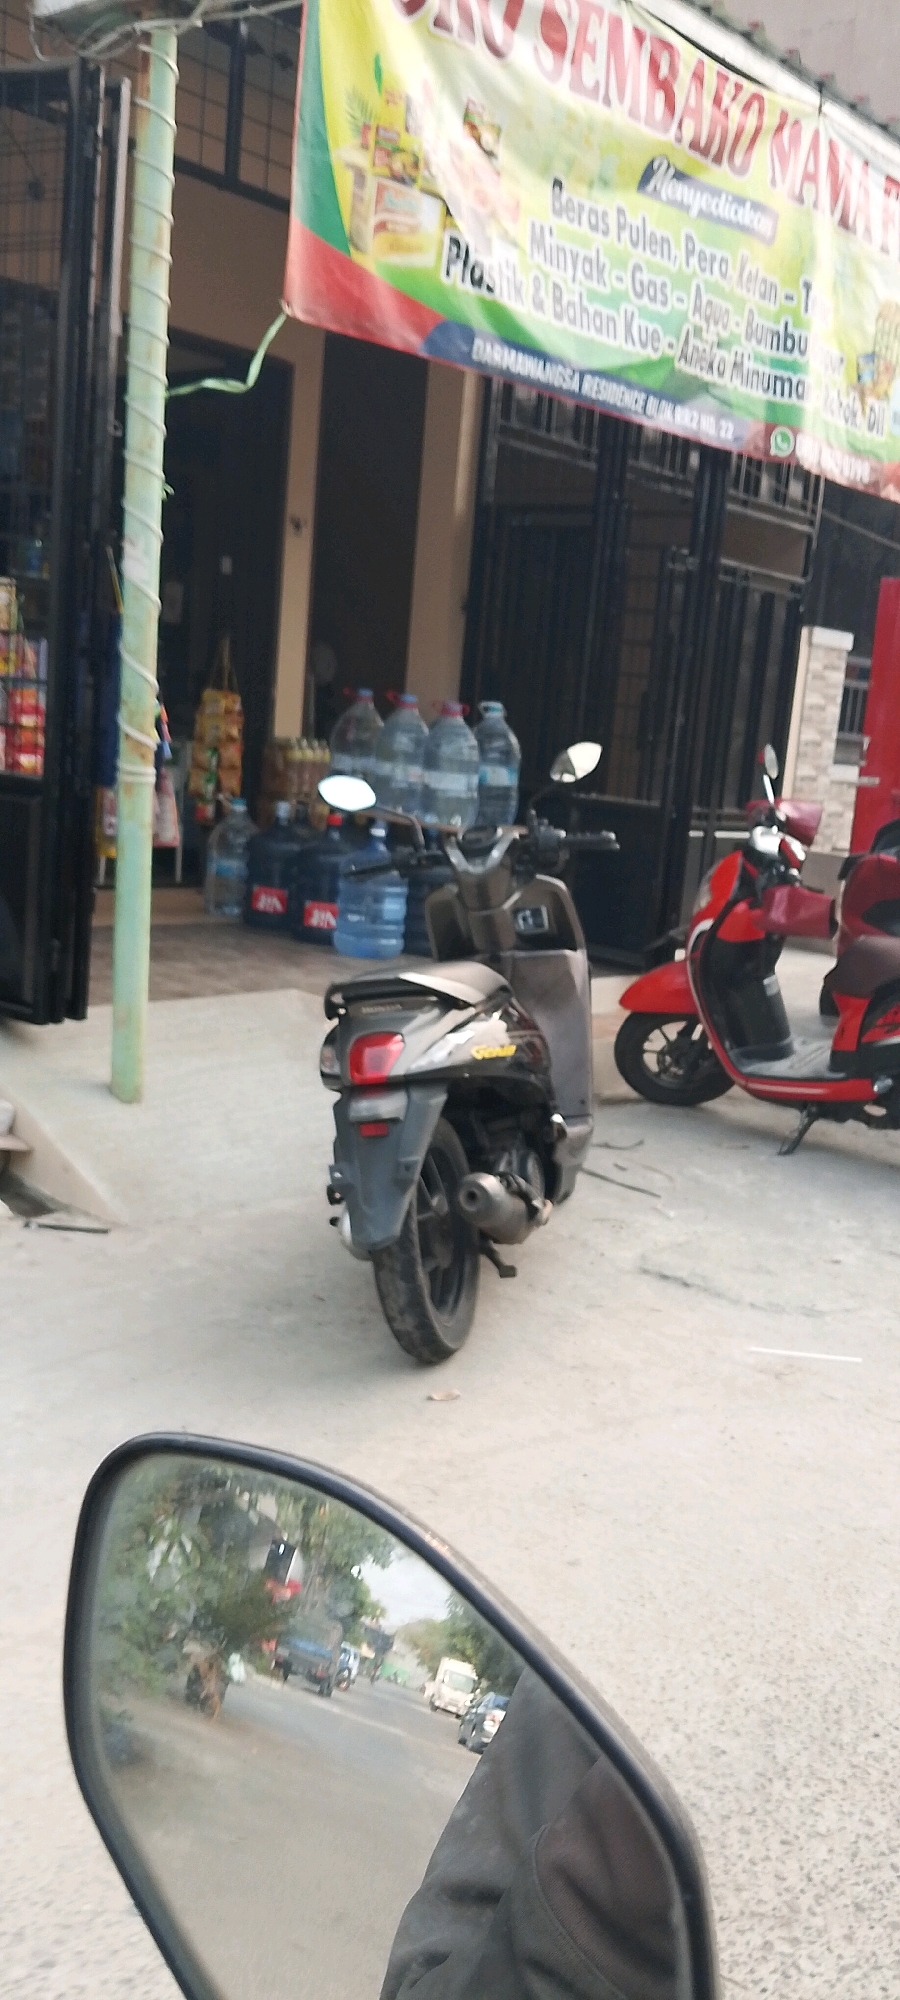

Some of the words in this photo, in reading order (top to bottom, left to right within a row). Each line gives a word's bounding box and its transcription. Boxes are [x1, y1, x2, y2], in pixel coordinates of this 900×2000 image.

[534, 0, 765, 176] SEMBAKO
[552, 178, 610, 237] Beras
[530, 220, 607, 287] Minyak
[631, 264, 668, 307] Gas
[744, 307, 808, 357] Bumbu
[552, 282, 617, 339] Bahan
[624, 308, 661, 353] Kue
[472, 337, 580, 394] DARMAWANGSA
